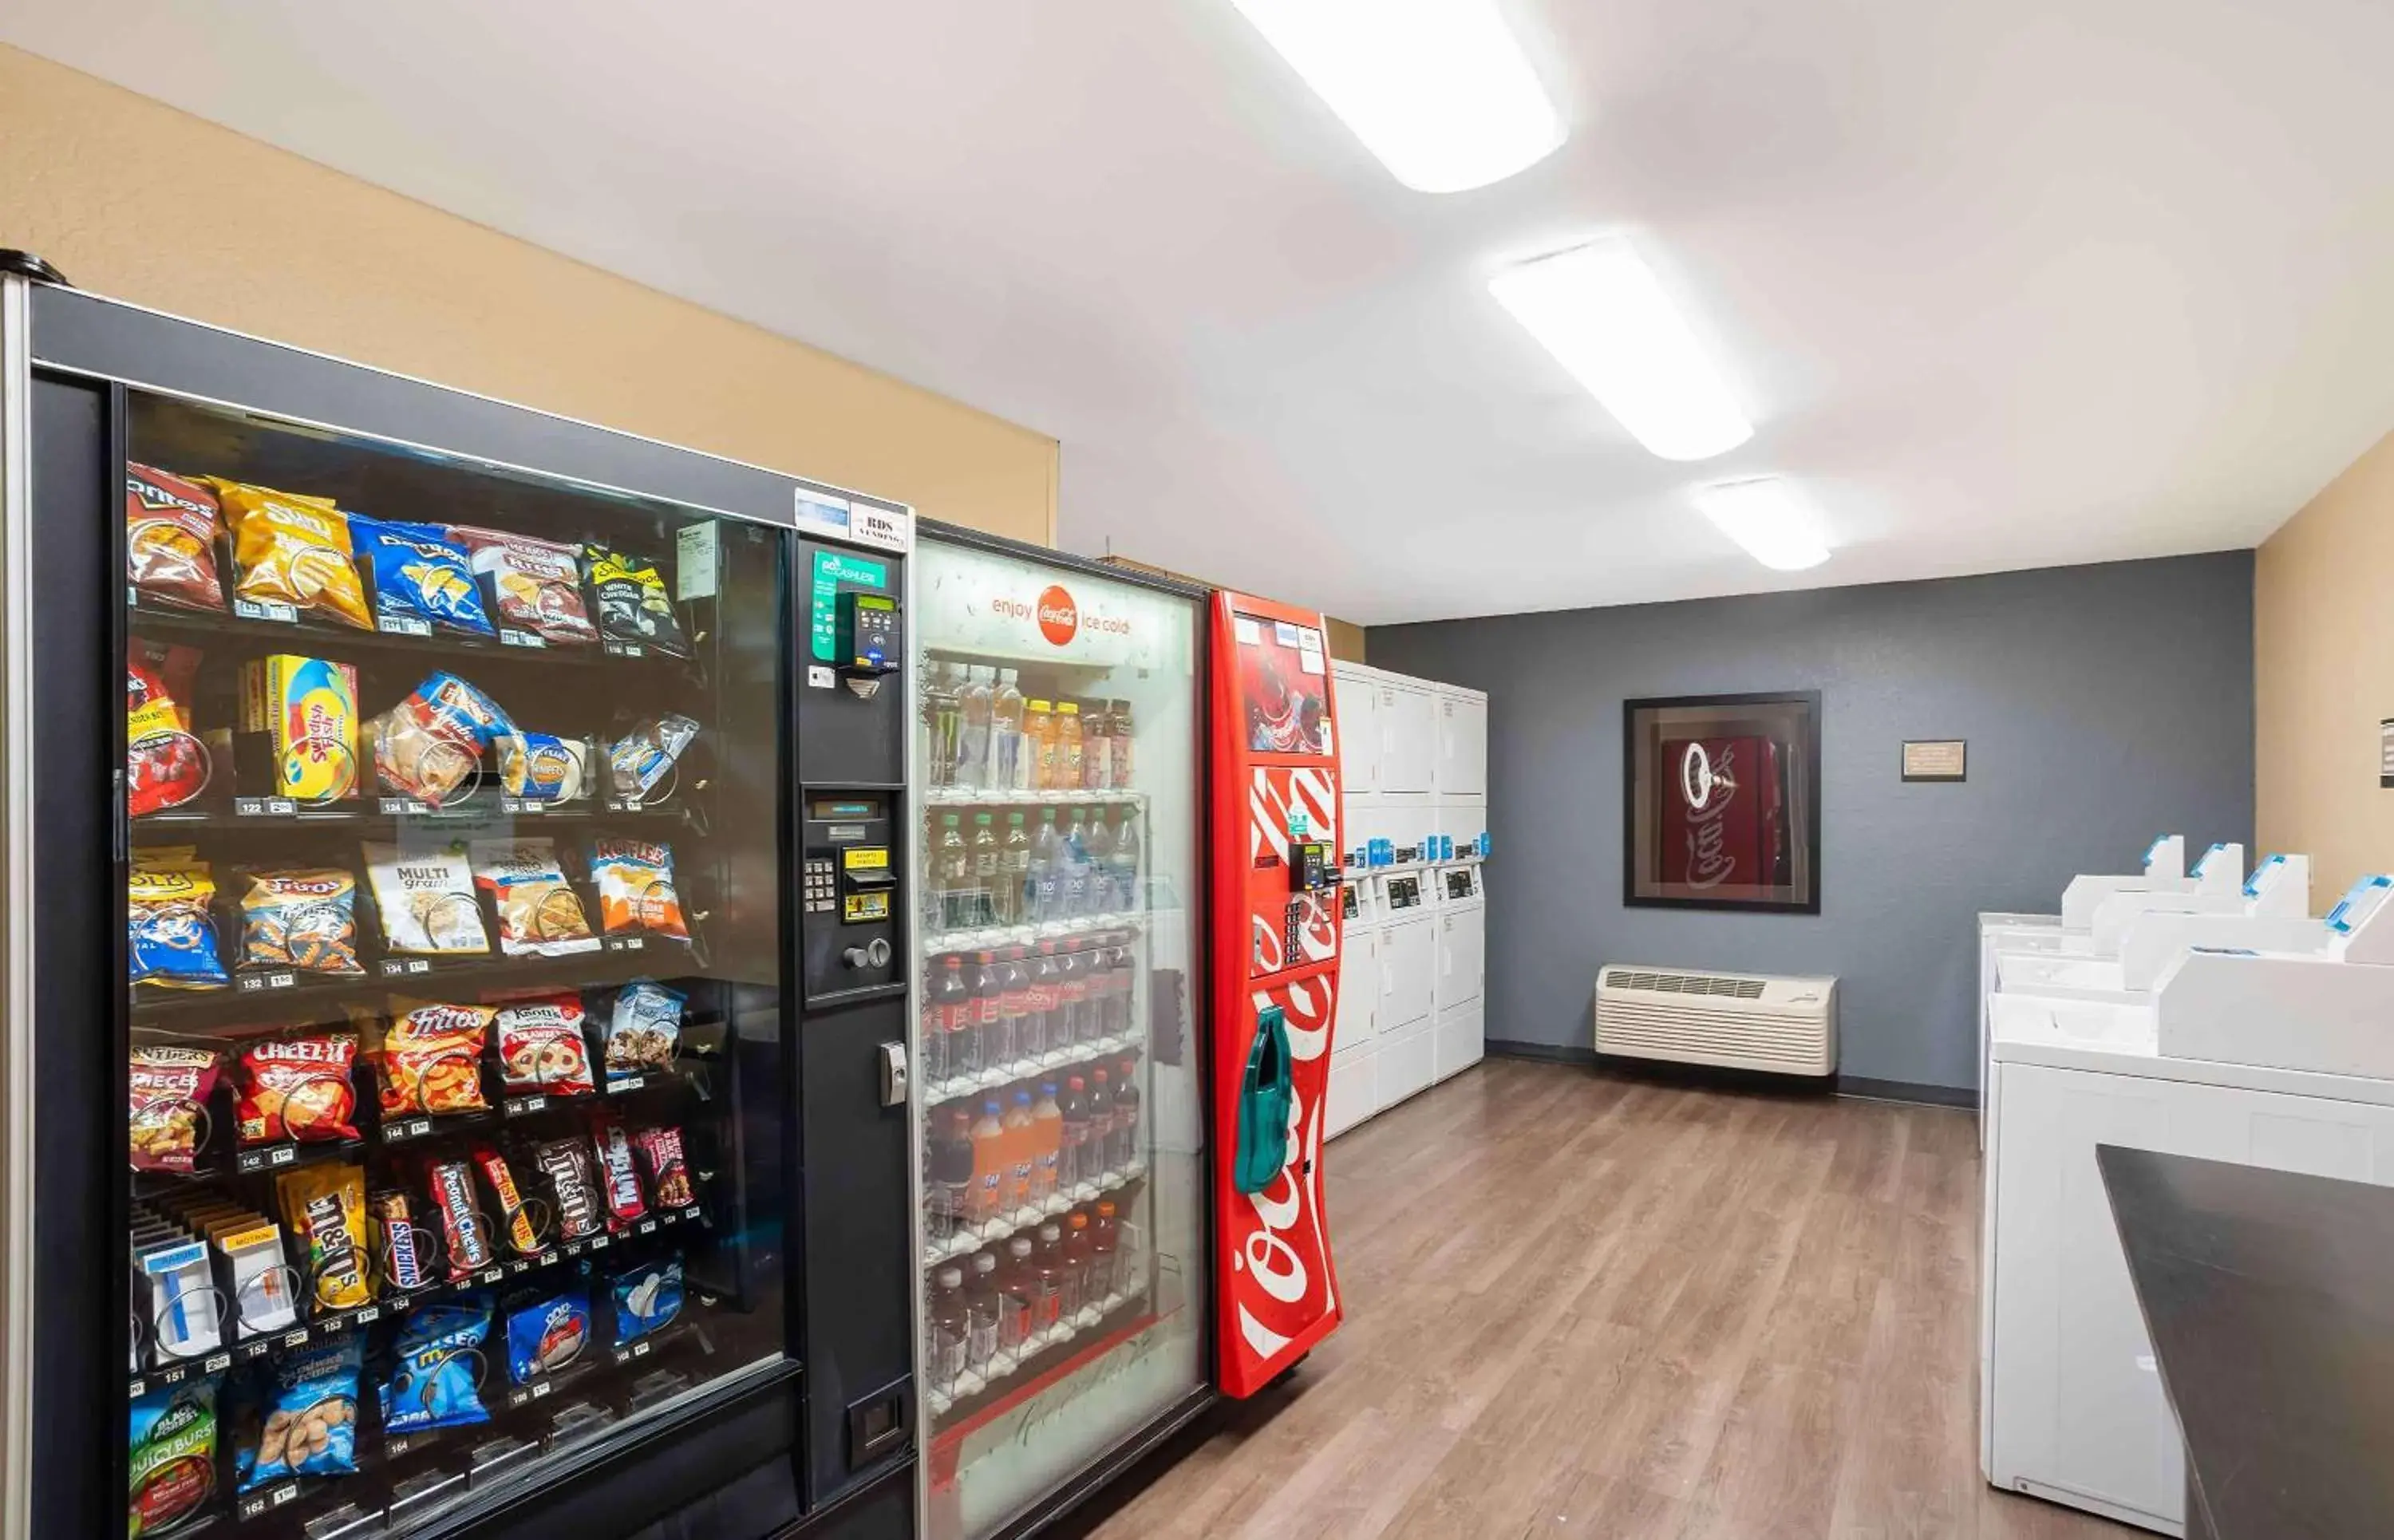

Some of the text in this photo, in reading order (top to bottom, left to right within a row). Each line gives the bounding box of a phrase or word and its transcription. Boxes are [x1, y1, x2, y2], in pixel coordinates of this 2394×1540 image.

[127, 480, 215, 520] oritos
[992, 598, 1033, 622] enjoy
[1101, 619, 1131, 636] cold
[309, 705, 326, 764] Swedish
[321, 715, 335, 750] Fish
[242, 804, 263, 813] 122
[397, 867, 449, 879] MULTI
[404, 879, 448, 890] grain
[242, 979, 263, 989] 132
[513, 1008, 561, 1021] Knott's
[408, 1005, 482, 1040] Fritos
[253, 1040, 349, 1064] CHEEZ-IT
[388, 1127, 403, 1139] 144
[242, 1157, 261, 1168] 142
[444, 1171, 481, 1264] Peanut Chews
[392, 1222, 421, 1287] SNICKERS
[393, 1299, 409, 1310] 154
[323, 1321, 342, 1333] 153
[247, 1344, 268, 1356] 152
[164, 1370, 186, 1384] 151
[390, 1442, 409, 1454] 164
[244, 1500, 264, 1515] 162
